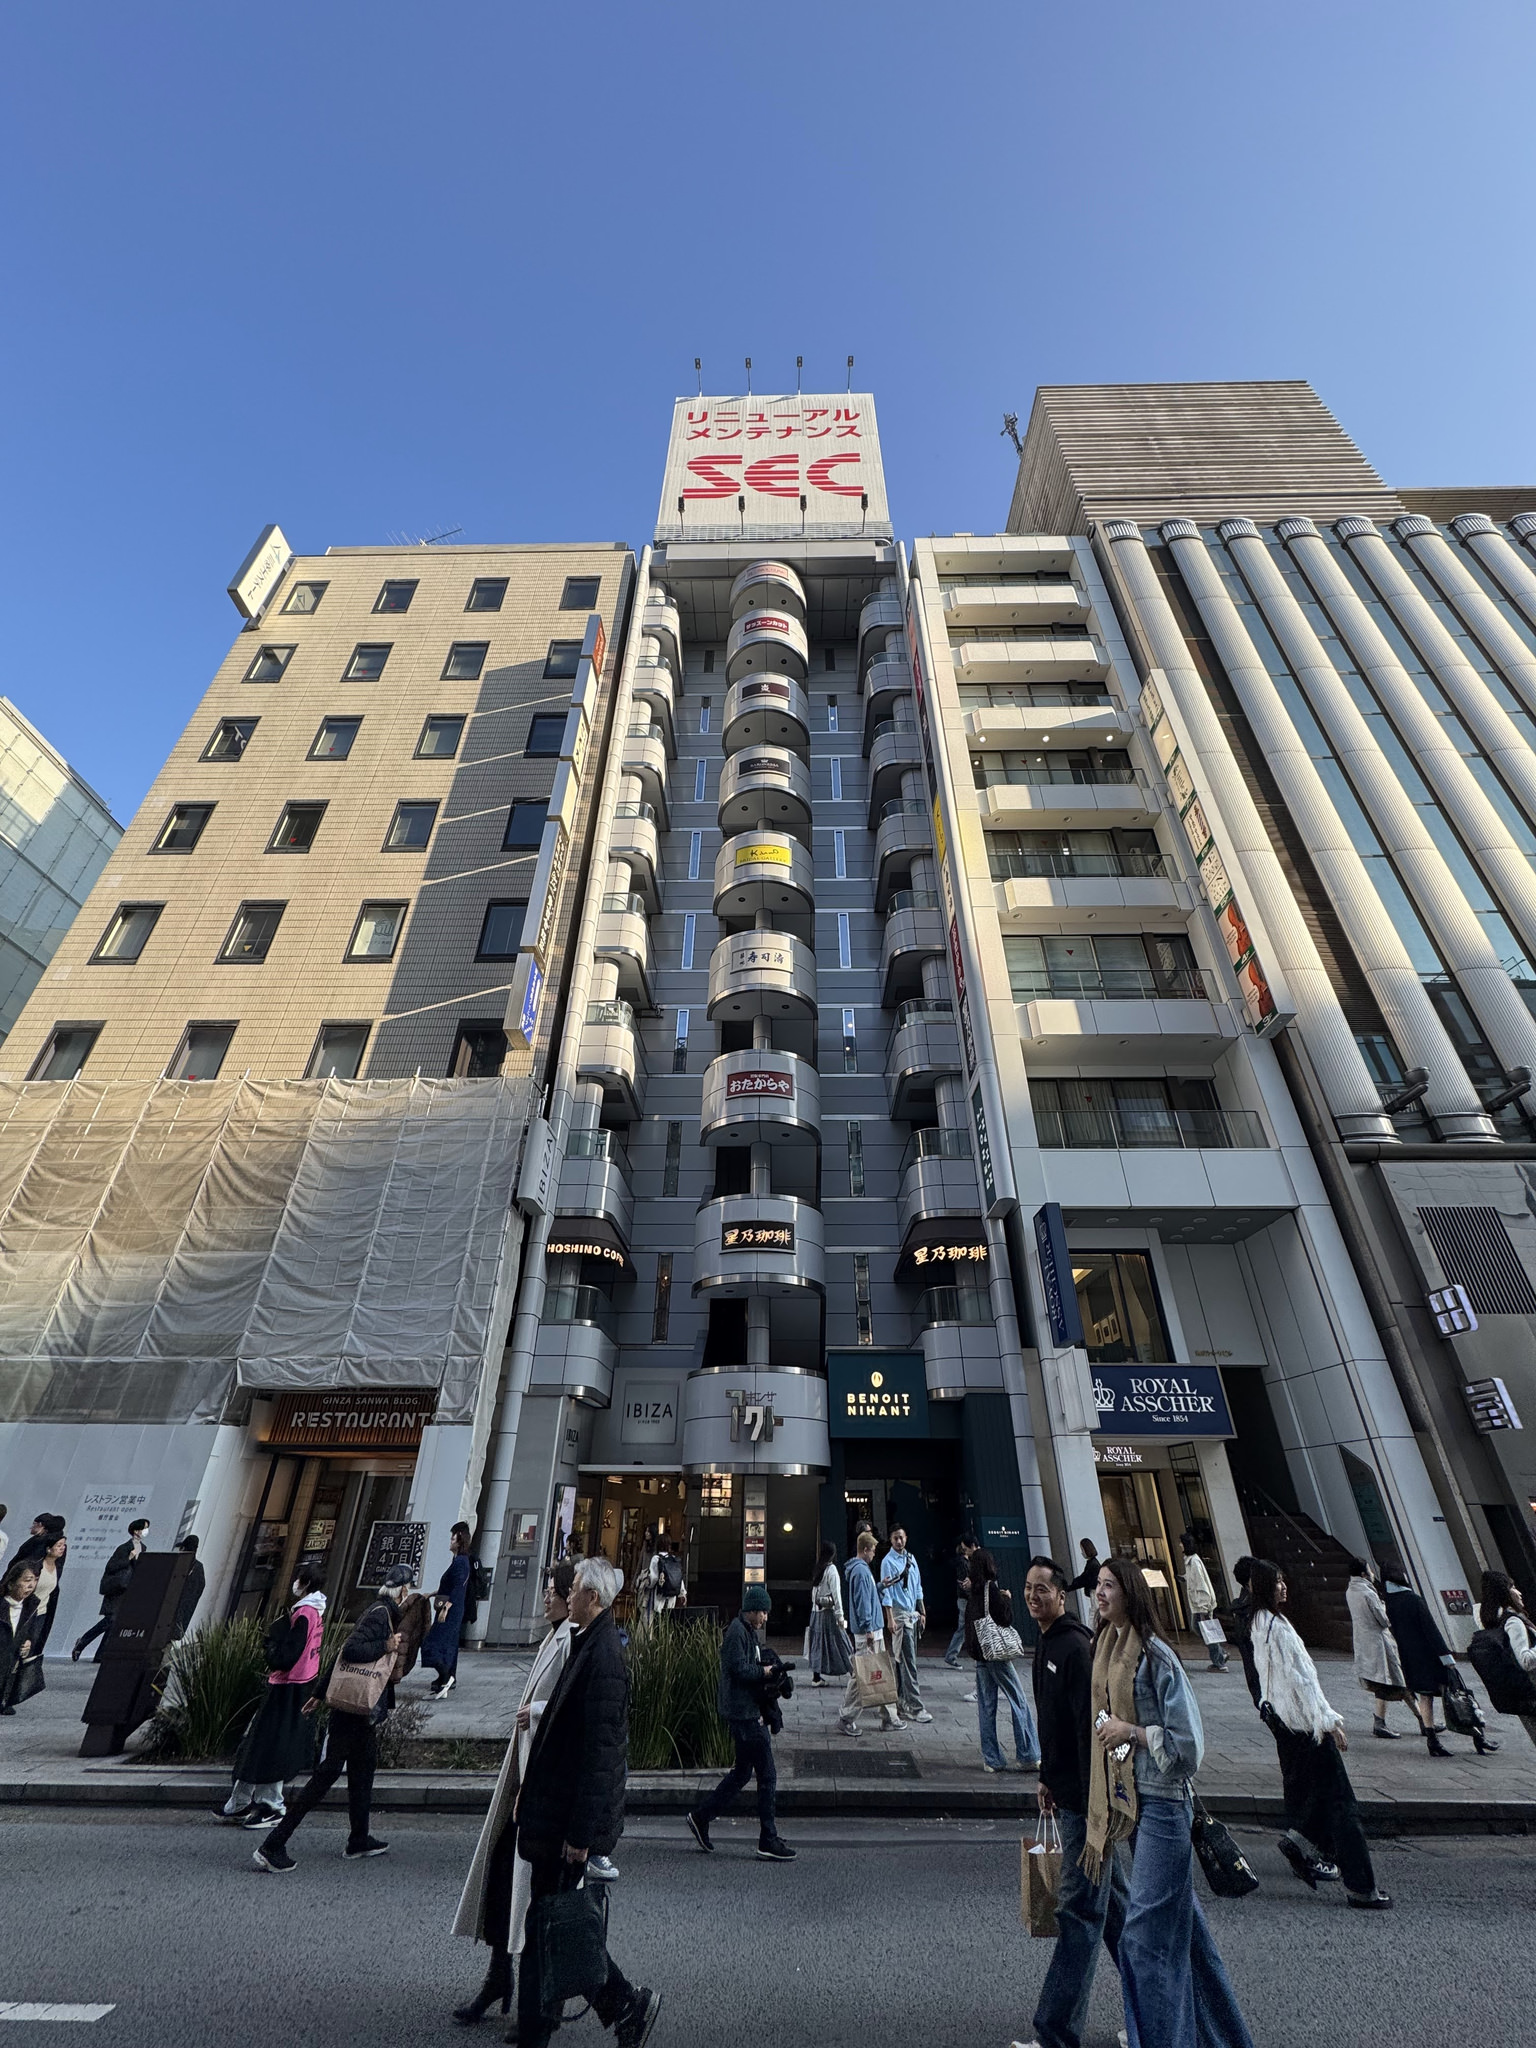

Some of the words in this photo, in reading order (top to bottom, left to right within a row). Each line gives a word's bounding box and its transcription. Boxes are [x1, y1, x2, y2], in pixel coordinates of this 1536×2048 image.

[687, 408, 861, 424] リニューアル
[686, 425, 863, 441] メンテナンス
[682, 452, 865, 499] SEC
[1241, 951, 1251, 964] 4F
[729, 1077, 790, 1093] おたからや
[537, 1138, 554, 1205] IBIZA
[724, 1228, 792, 1246] 星乃珈琲
[546, 1243, 602, 1256] HOSHINO
[913, 1244, 988, 1266] 星乃珈琲
[1129, 1378, 1198, 1395] ROYAL
[322, 1396, 352, 1405] GINZA
[355, 1396, 389, 1405] SANWA
[393, 1396, 421, 1405] BLDG.
[847, 1393, 910, 1404] BENOIT
[1120, 1395, 1216, 1413] ASSCHER
[626, 1402, 673, 1418] IBIZA
[847, 1405, 911, 1416] NIHANT
[1152, 1414, 1171, 1423] Since
[1173, 1414, 1189, 1423] 1854
[565, 1428, 579, 1443] IBIZA
[1106, 1446, 1136, 1455] ROYAL
[1102, 1454, 1143, 1463] ASSCHER
[84, 1494, 146, 1505] レストラン営業中
[380, 1536, 413, 1551] 銀座
[379, 1552, 408, 1566] 4丁目
[339, 1662, 381, 1680] Standard
